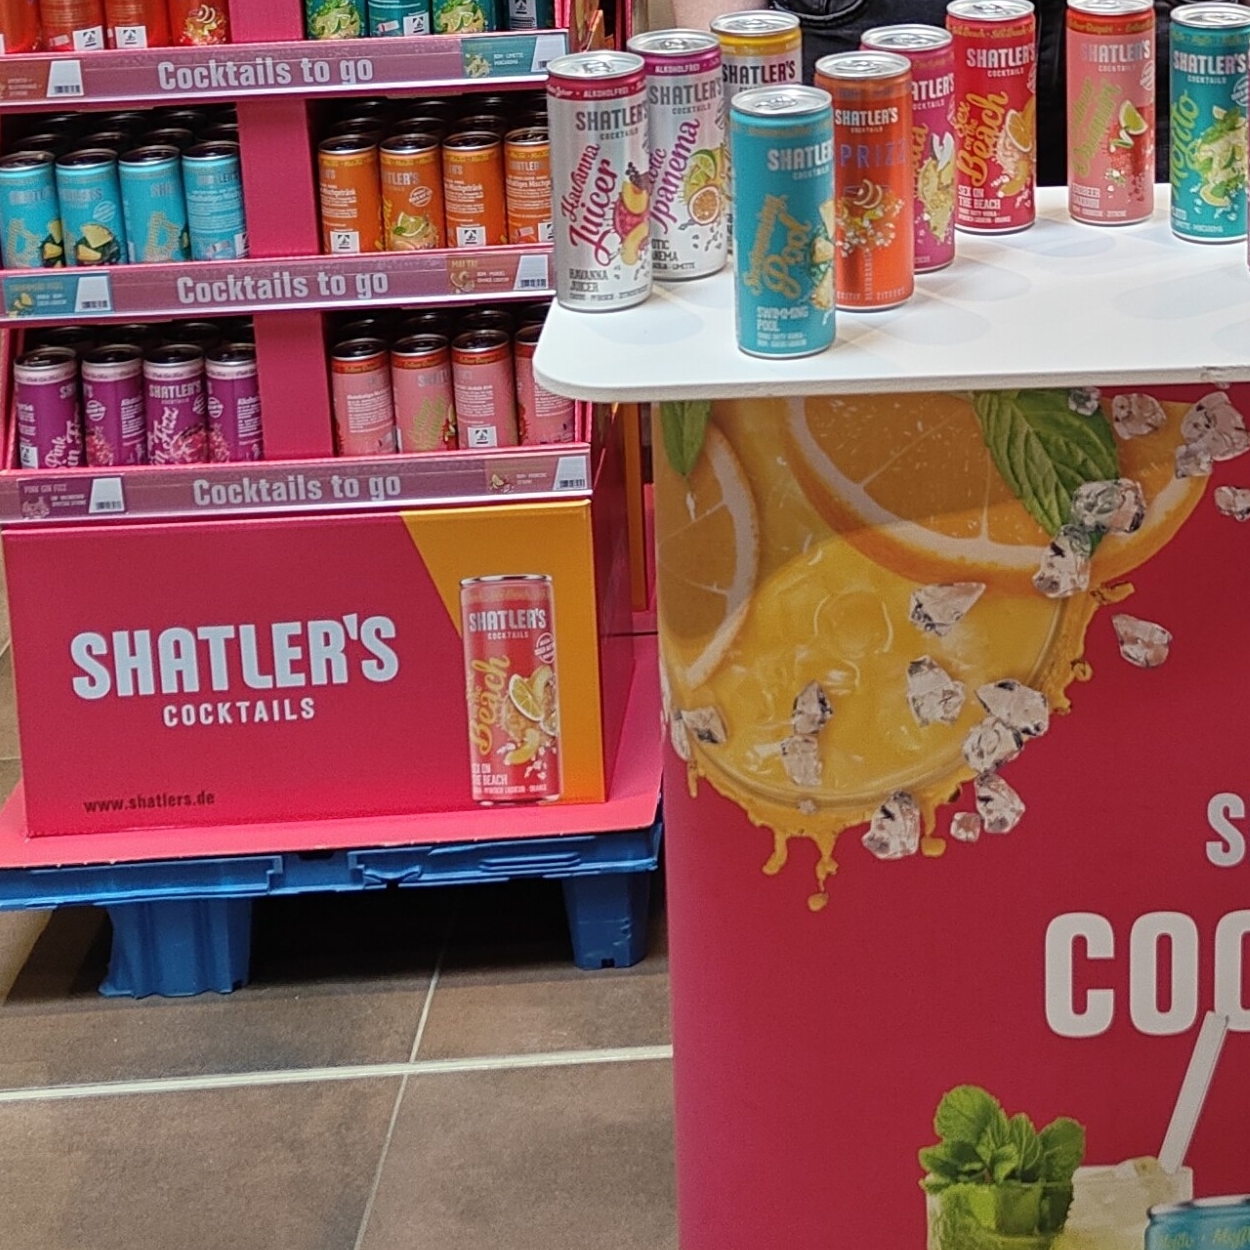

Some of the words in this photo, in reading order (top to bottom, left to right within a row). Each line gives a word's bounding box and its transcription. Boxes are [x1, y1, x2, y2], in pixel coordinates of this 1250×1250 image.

[966, 43, 1035, 69] SHATLER'S
[1081, 39, 1151, 63] SHATLER'S
[1173, 50, 1247, 73] SHATLER'S
[157, 57, 292, 91] Cocktails
[301, 58, 330, 84] to
[339, 58, 373, 85] go
[722, 62, 796, 86] SHATLER'S
[911, 72, 955, 102] ATLER'S
[650, 76, 723, 106] SHATLER'S
[834, 106, 899, 126] SHATLER'S
[913, 98, 946, 111] OCKTAILS
[956, 91, 1009, 186] Beach
[767, 146, 833, 173] SHATLE
[957, 184, 971, 197] SEX
[972, 185, 984, 197] ON
[973, 198, 1001, 210] BEACH
[176, 271, 309, 304] Cocktails
[317, 271, 347, 297] to
[355, 272, 389, 299] go
[193, 473, 323, 506] Cocktails
[330, 474, 360, 498] to
[368, 475, 401, 501] go
[468, 607, 547, 633] SHATLER'S
[70, 611, 400, 700] SHATLER'S
[162, 696, 316, 727] COCKTAILS
[483, 774, 508, 787] BEACH
[82, 790, 216, 814] www.shatlers.de
